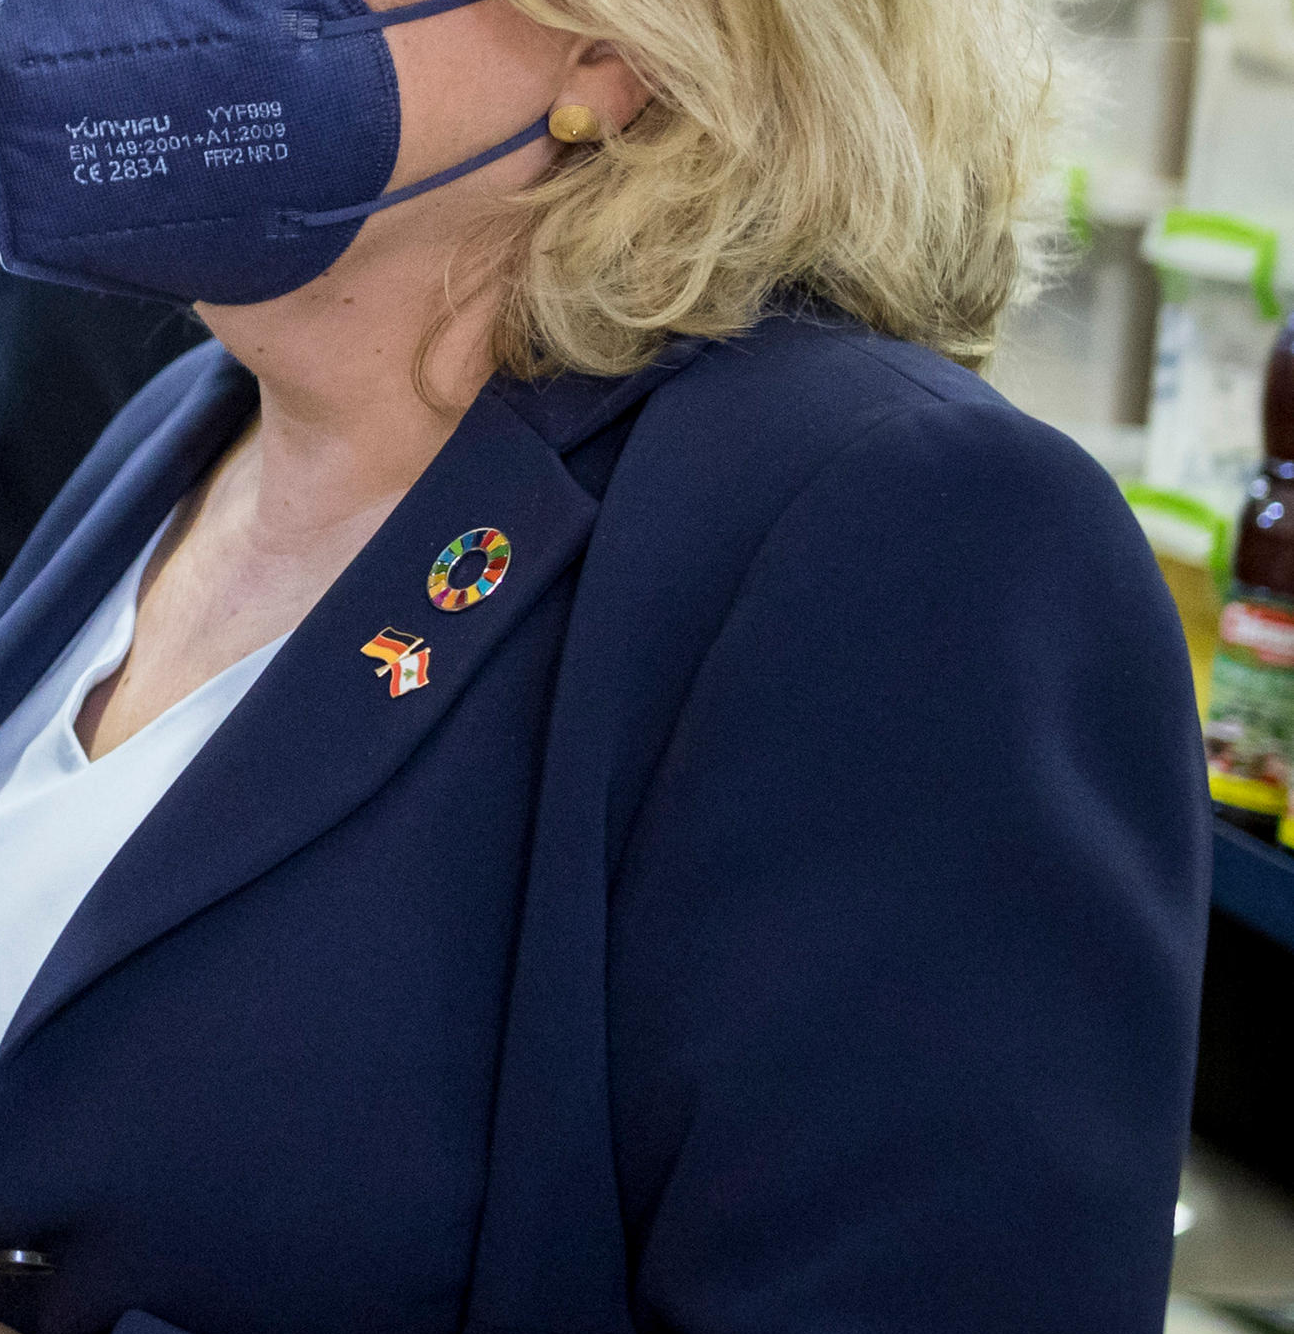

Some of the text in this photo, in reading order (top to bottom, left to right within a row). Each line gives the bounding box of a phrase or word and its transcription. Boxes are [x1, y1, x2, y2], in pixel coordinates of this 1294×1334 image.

[207, 100, 283, 124] YYF999
[69, 142, 98, 161] EN
[108, 155, 169, 182] 2834
[203, 147, 246, 168] FFP2
